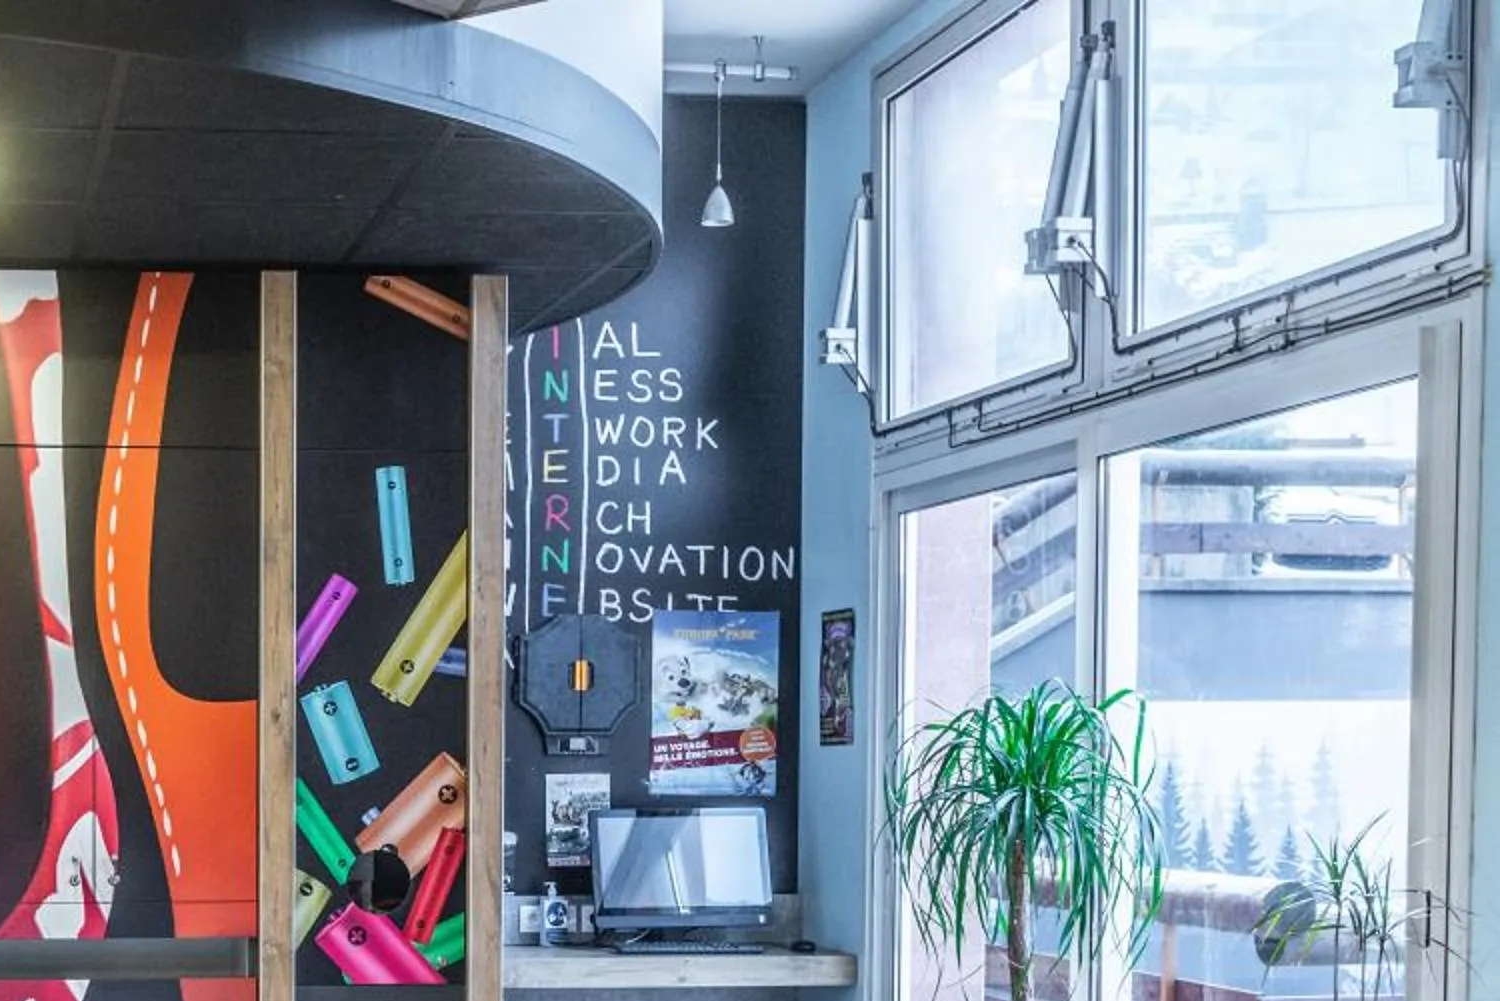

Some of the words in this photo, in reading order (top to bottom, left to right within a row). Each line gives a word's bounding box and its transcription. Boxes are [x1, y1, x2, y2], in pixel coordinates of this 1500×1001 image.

[592, 321, 661, 359] AL
[594, 368, 684, 403] ESS
[595, 414, 720, 451] WORK
[596, 501, 651, 535] CH
[596, 543, 795, 581] OVATION
